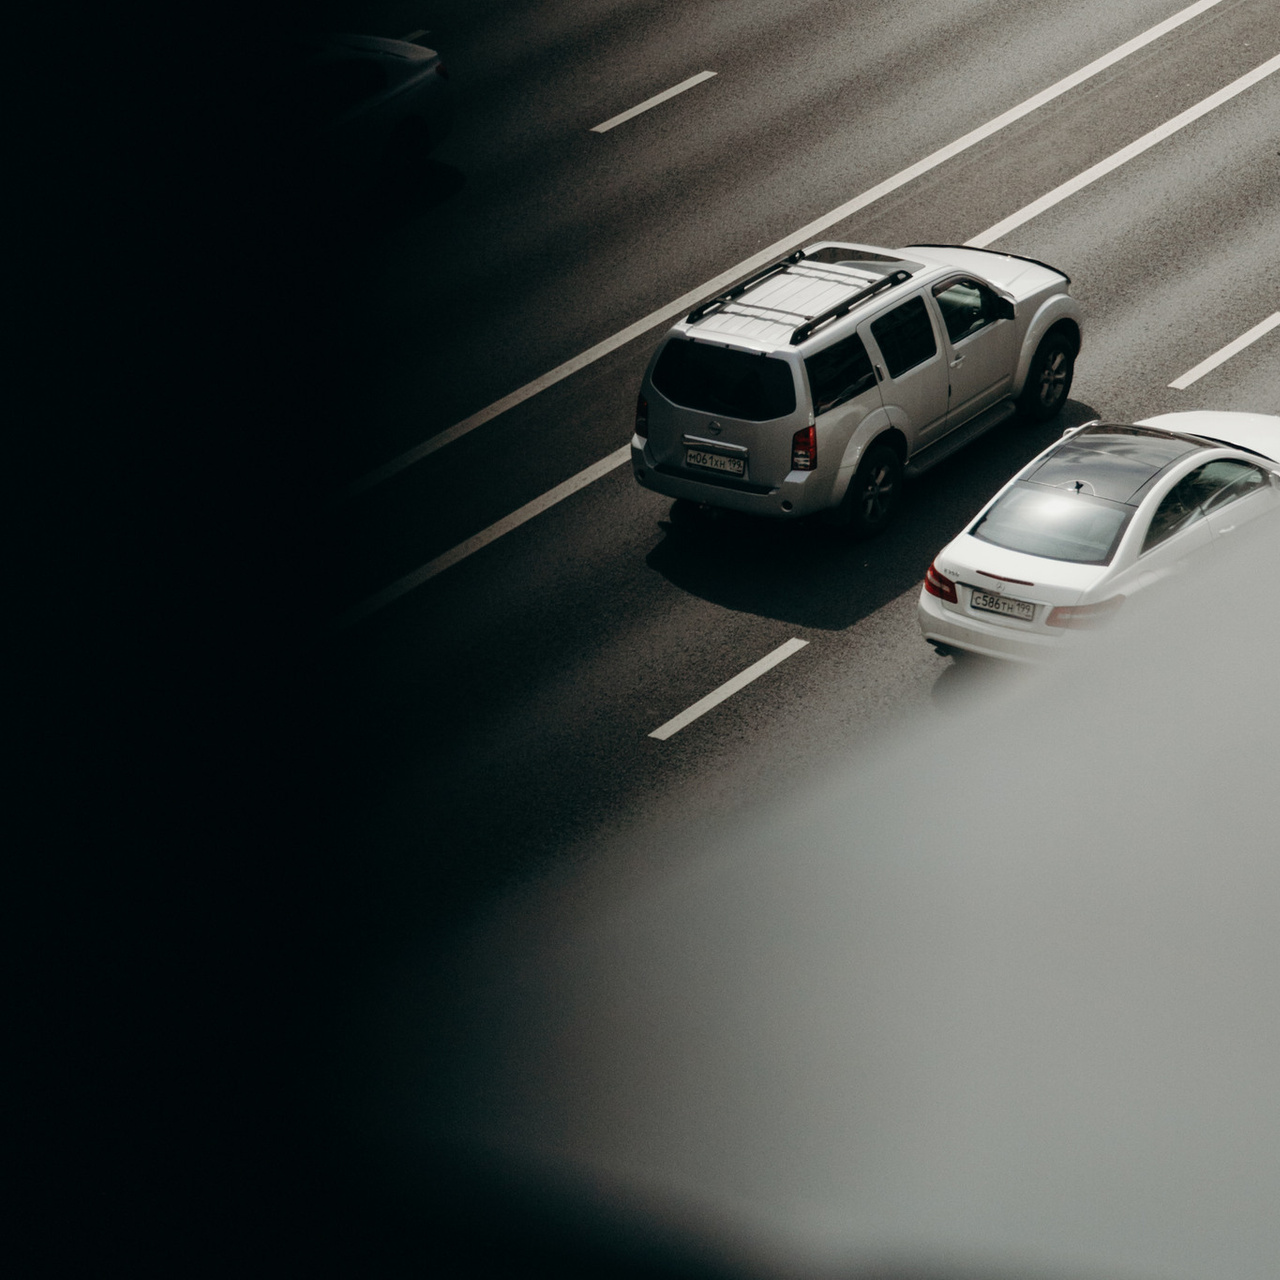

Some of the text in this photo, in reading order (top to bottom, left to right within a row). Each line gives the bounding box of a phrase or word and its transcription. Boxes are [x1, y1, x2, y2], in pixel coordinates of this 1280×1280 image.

[688, 452, 726, 469] М061ХН
[974, 593, 1031, 614] С586ТН 199
